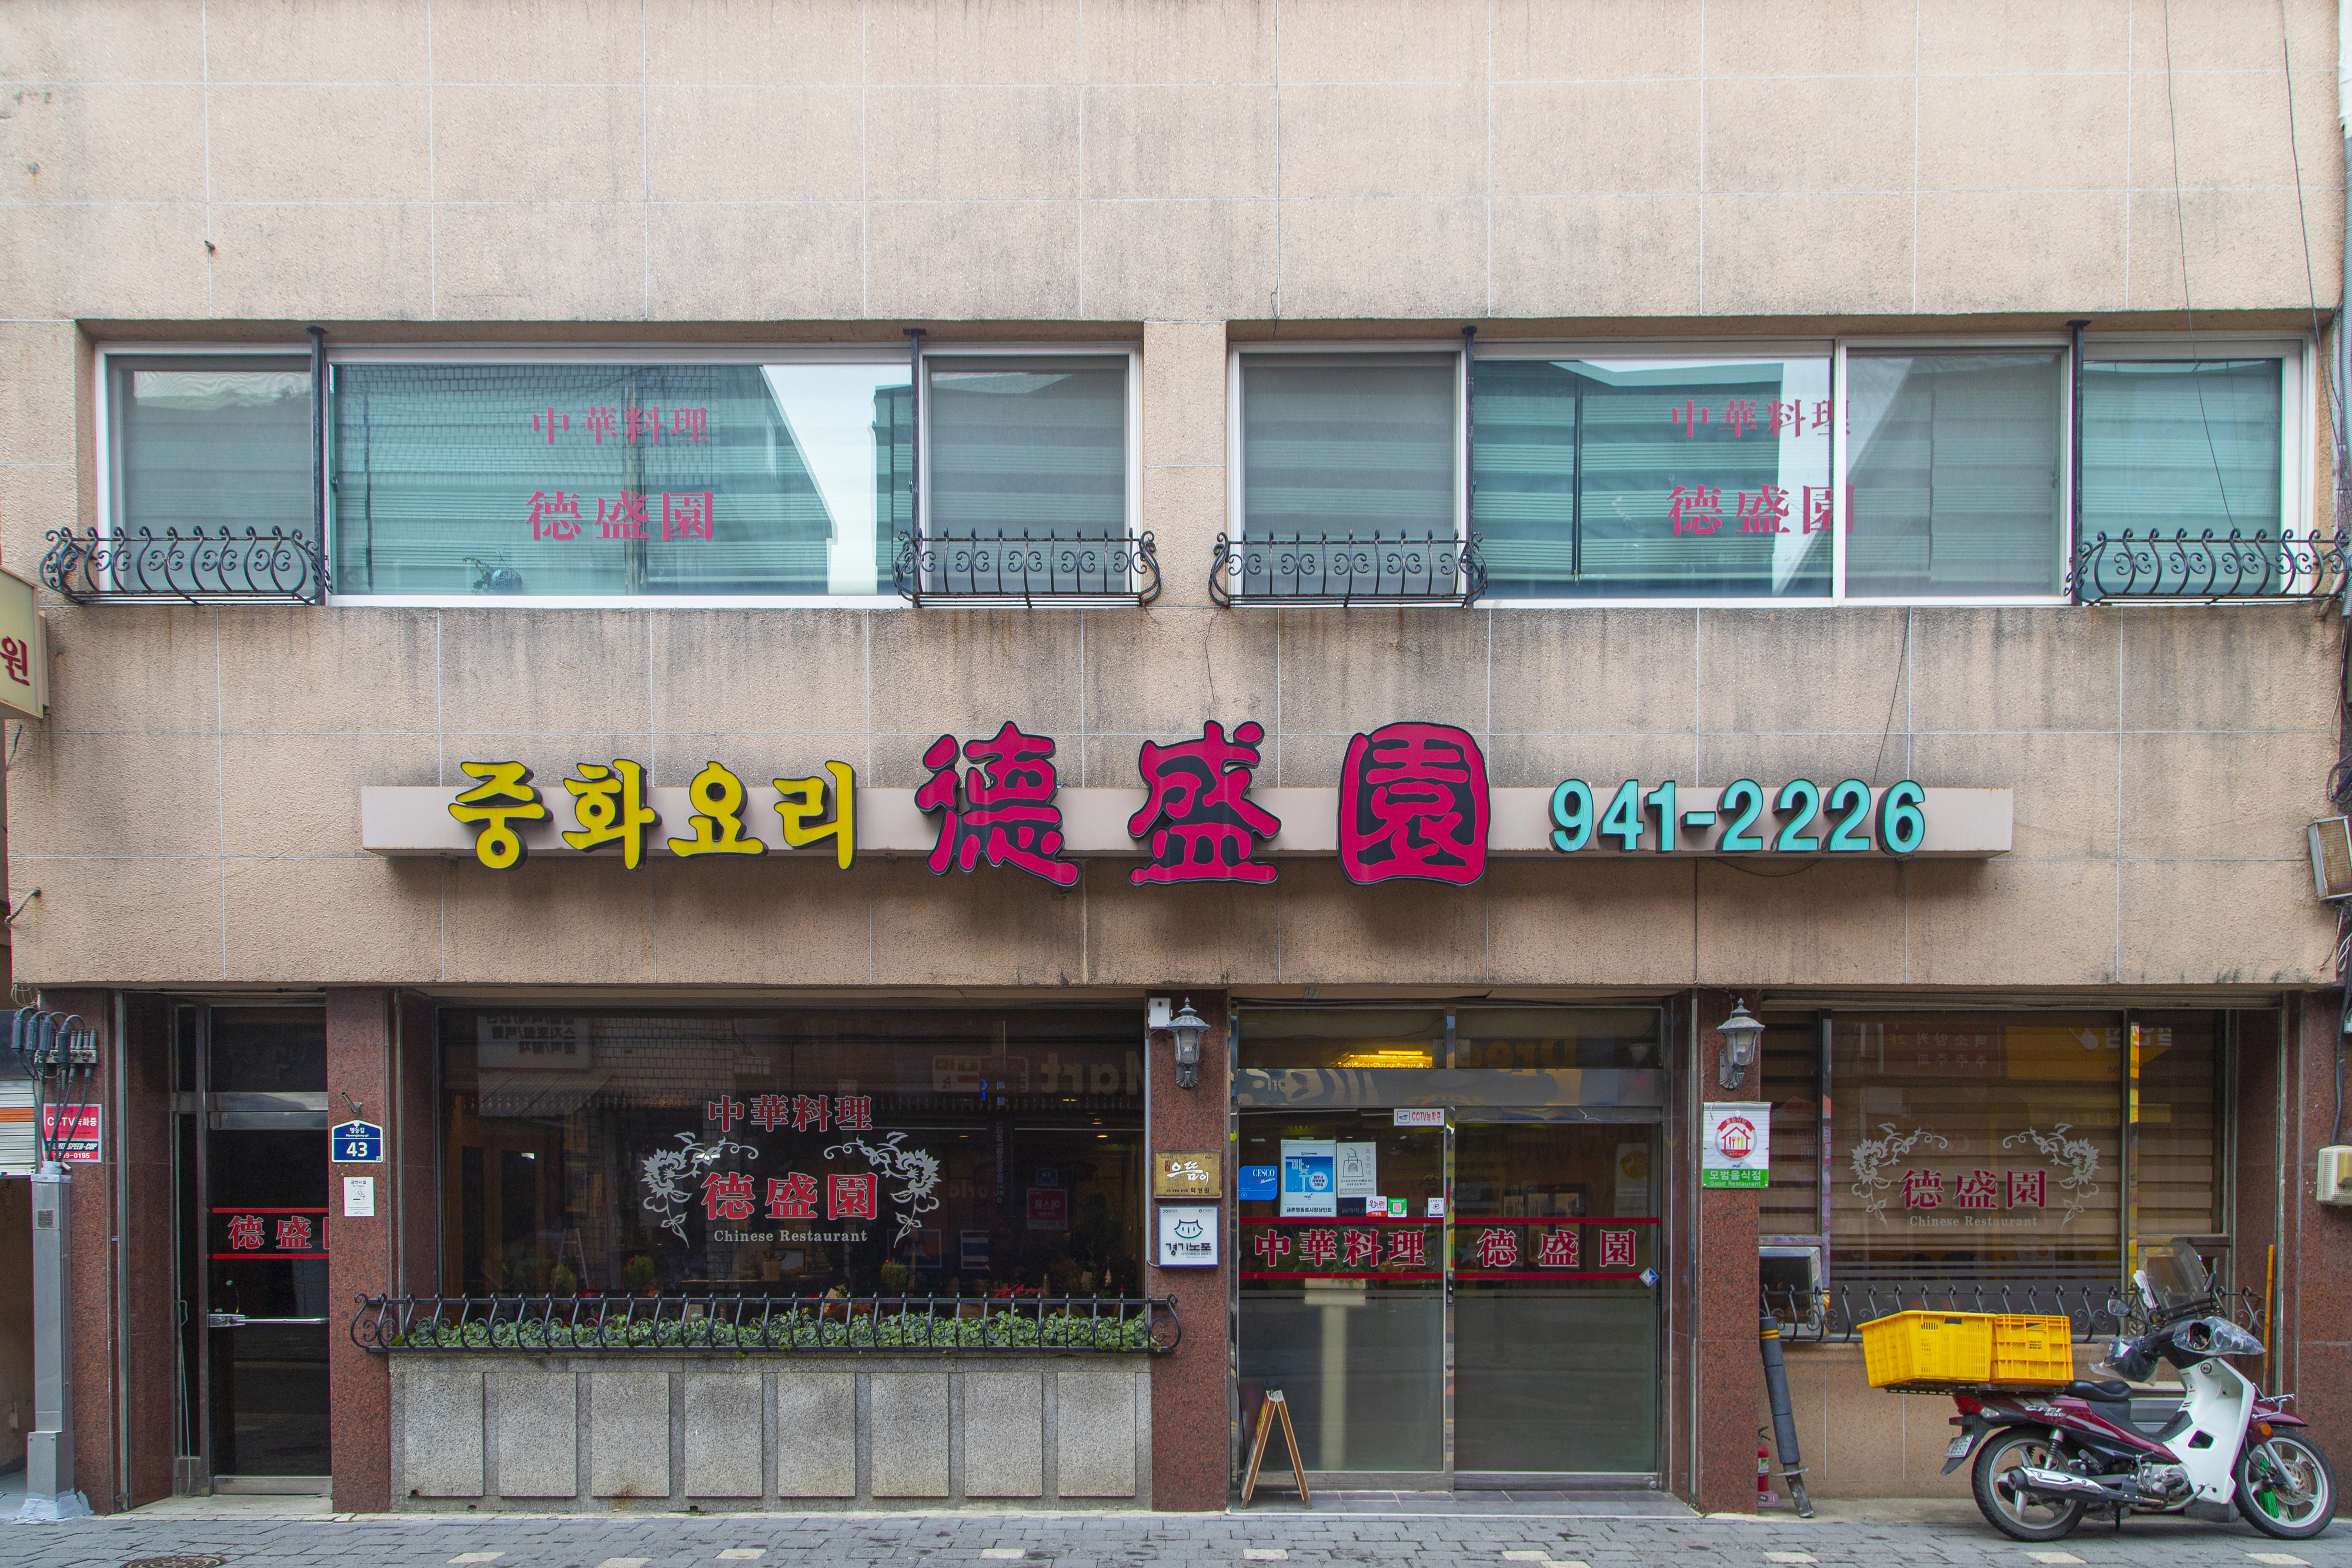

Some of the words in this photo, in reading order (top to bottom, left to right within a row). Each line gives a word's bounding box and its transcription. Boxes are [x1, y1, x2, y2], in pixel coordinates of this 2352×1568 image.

[533, 406, 708, 444] 中華料理
[526, 490, 714, 540] 德盛園
[0, 636, 30, 686] 원
[448, 759, 857, 870] 중화요리
[914, 720, 1492, 885] 德盛園
[1549, 778, 1926, 855] 941-2226
[709, 1095, 873, 1132] 中華料理
[1412, 1112, 1441, 1123] CCTV녹화중
[346, 1142, 368, 1157] 43
[1167, 1161, 1209, 1186] 으뜸이
[1252, 1169, 1275, 1177] CESCO
[1710, 1171, 1761, 1181] 모범음식점
[1899, 1169, 2046, 1209] 德盛園
[700, 1172, 878, 1220] 德盛園
[228, 1215, 329, 1249] 德盛
[714, 1231, 773, 1242] Chinese
[779, 1231, 867, 1242] Restaurant
[1909, 1216, 1959, 1226] Chinese
[1965, 1216, 2037, 1226] Restaurant
[1165, 1243, 1212, 1256] 경기노포
[1255, 1229, 1426, 1268] 中華料理
[1476, 1228, 1636, 1268] 德盛園
